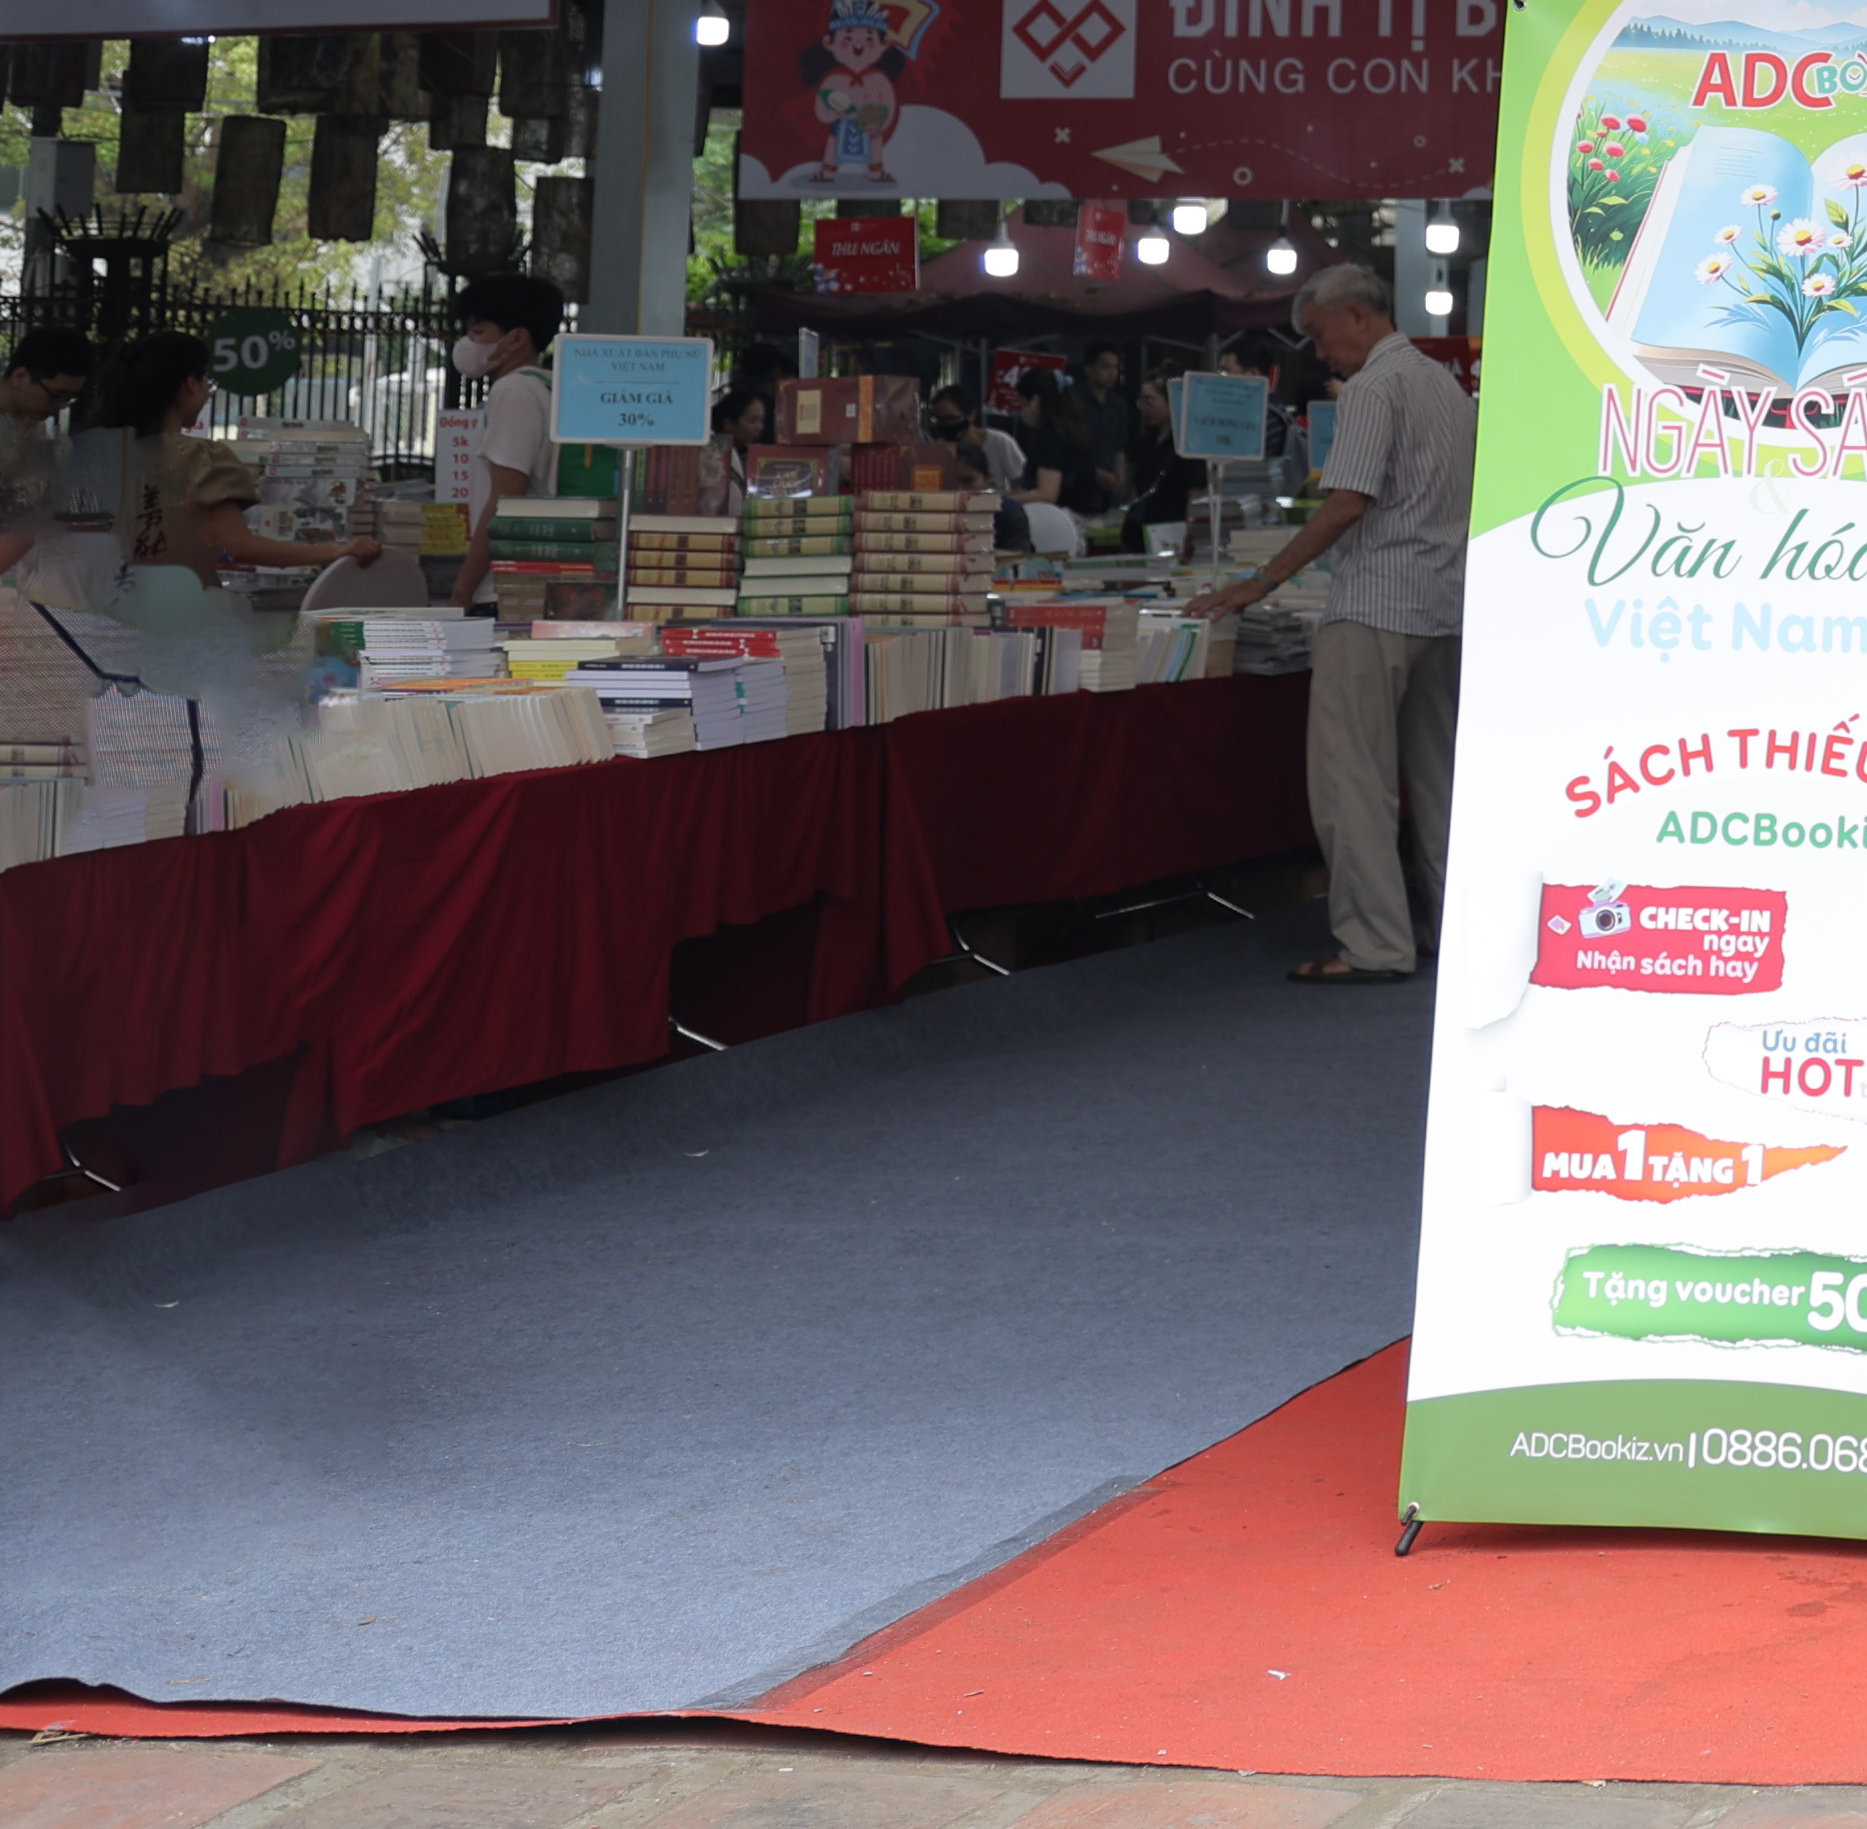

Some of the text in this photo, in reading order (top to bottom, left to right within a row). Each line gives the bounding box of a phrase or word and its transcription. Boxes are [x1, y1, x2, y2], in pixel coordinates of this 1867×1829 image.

[1169, 49, 1429, 95] CÙNG CON
[1692, 51, 1835, 108] ADC
[832, 241, 857, 257] THU
[212, 329, 296, 371] 50%
[639, 362, 666, 371] NAM
[617, 413, 655, 427] 30%
[1597, 365, 1775, 480] NGÀY
[1529, 474, 1743, 587] Văn
[1585, 598, 1713, 663] Việt
[1565, 733, 1714, 819] SÁCH
[1640, 905, 1771, 935] CHECK-IN
[1703, 931, 1770, 957] ngay
[1577, 950, 1759, 983] Nhận sách hay
[1761, 1028, 1848, 1055] Ưu đãi
[1761, 1056, 1863, 1097] HOT
[1543, 1129, 1764, 1188] MUA 1 TẶNG 1
[1583, 1270, 1668, 1307] Tặng
[1676, 1277, 1805, 1306] voucher
[1510, 1433, 1684, 1463] ADCBookiz.vn
